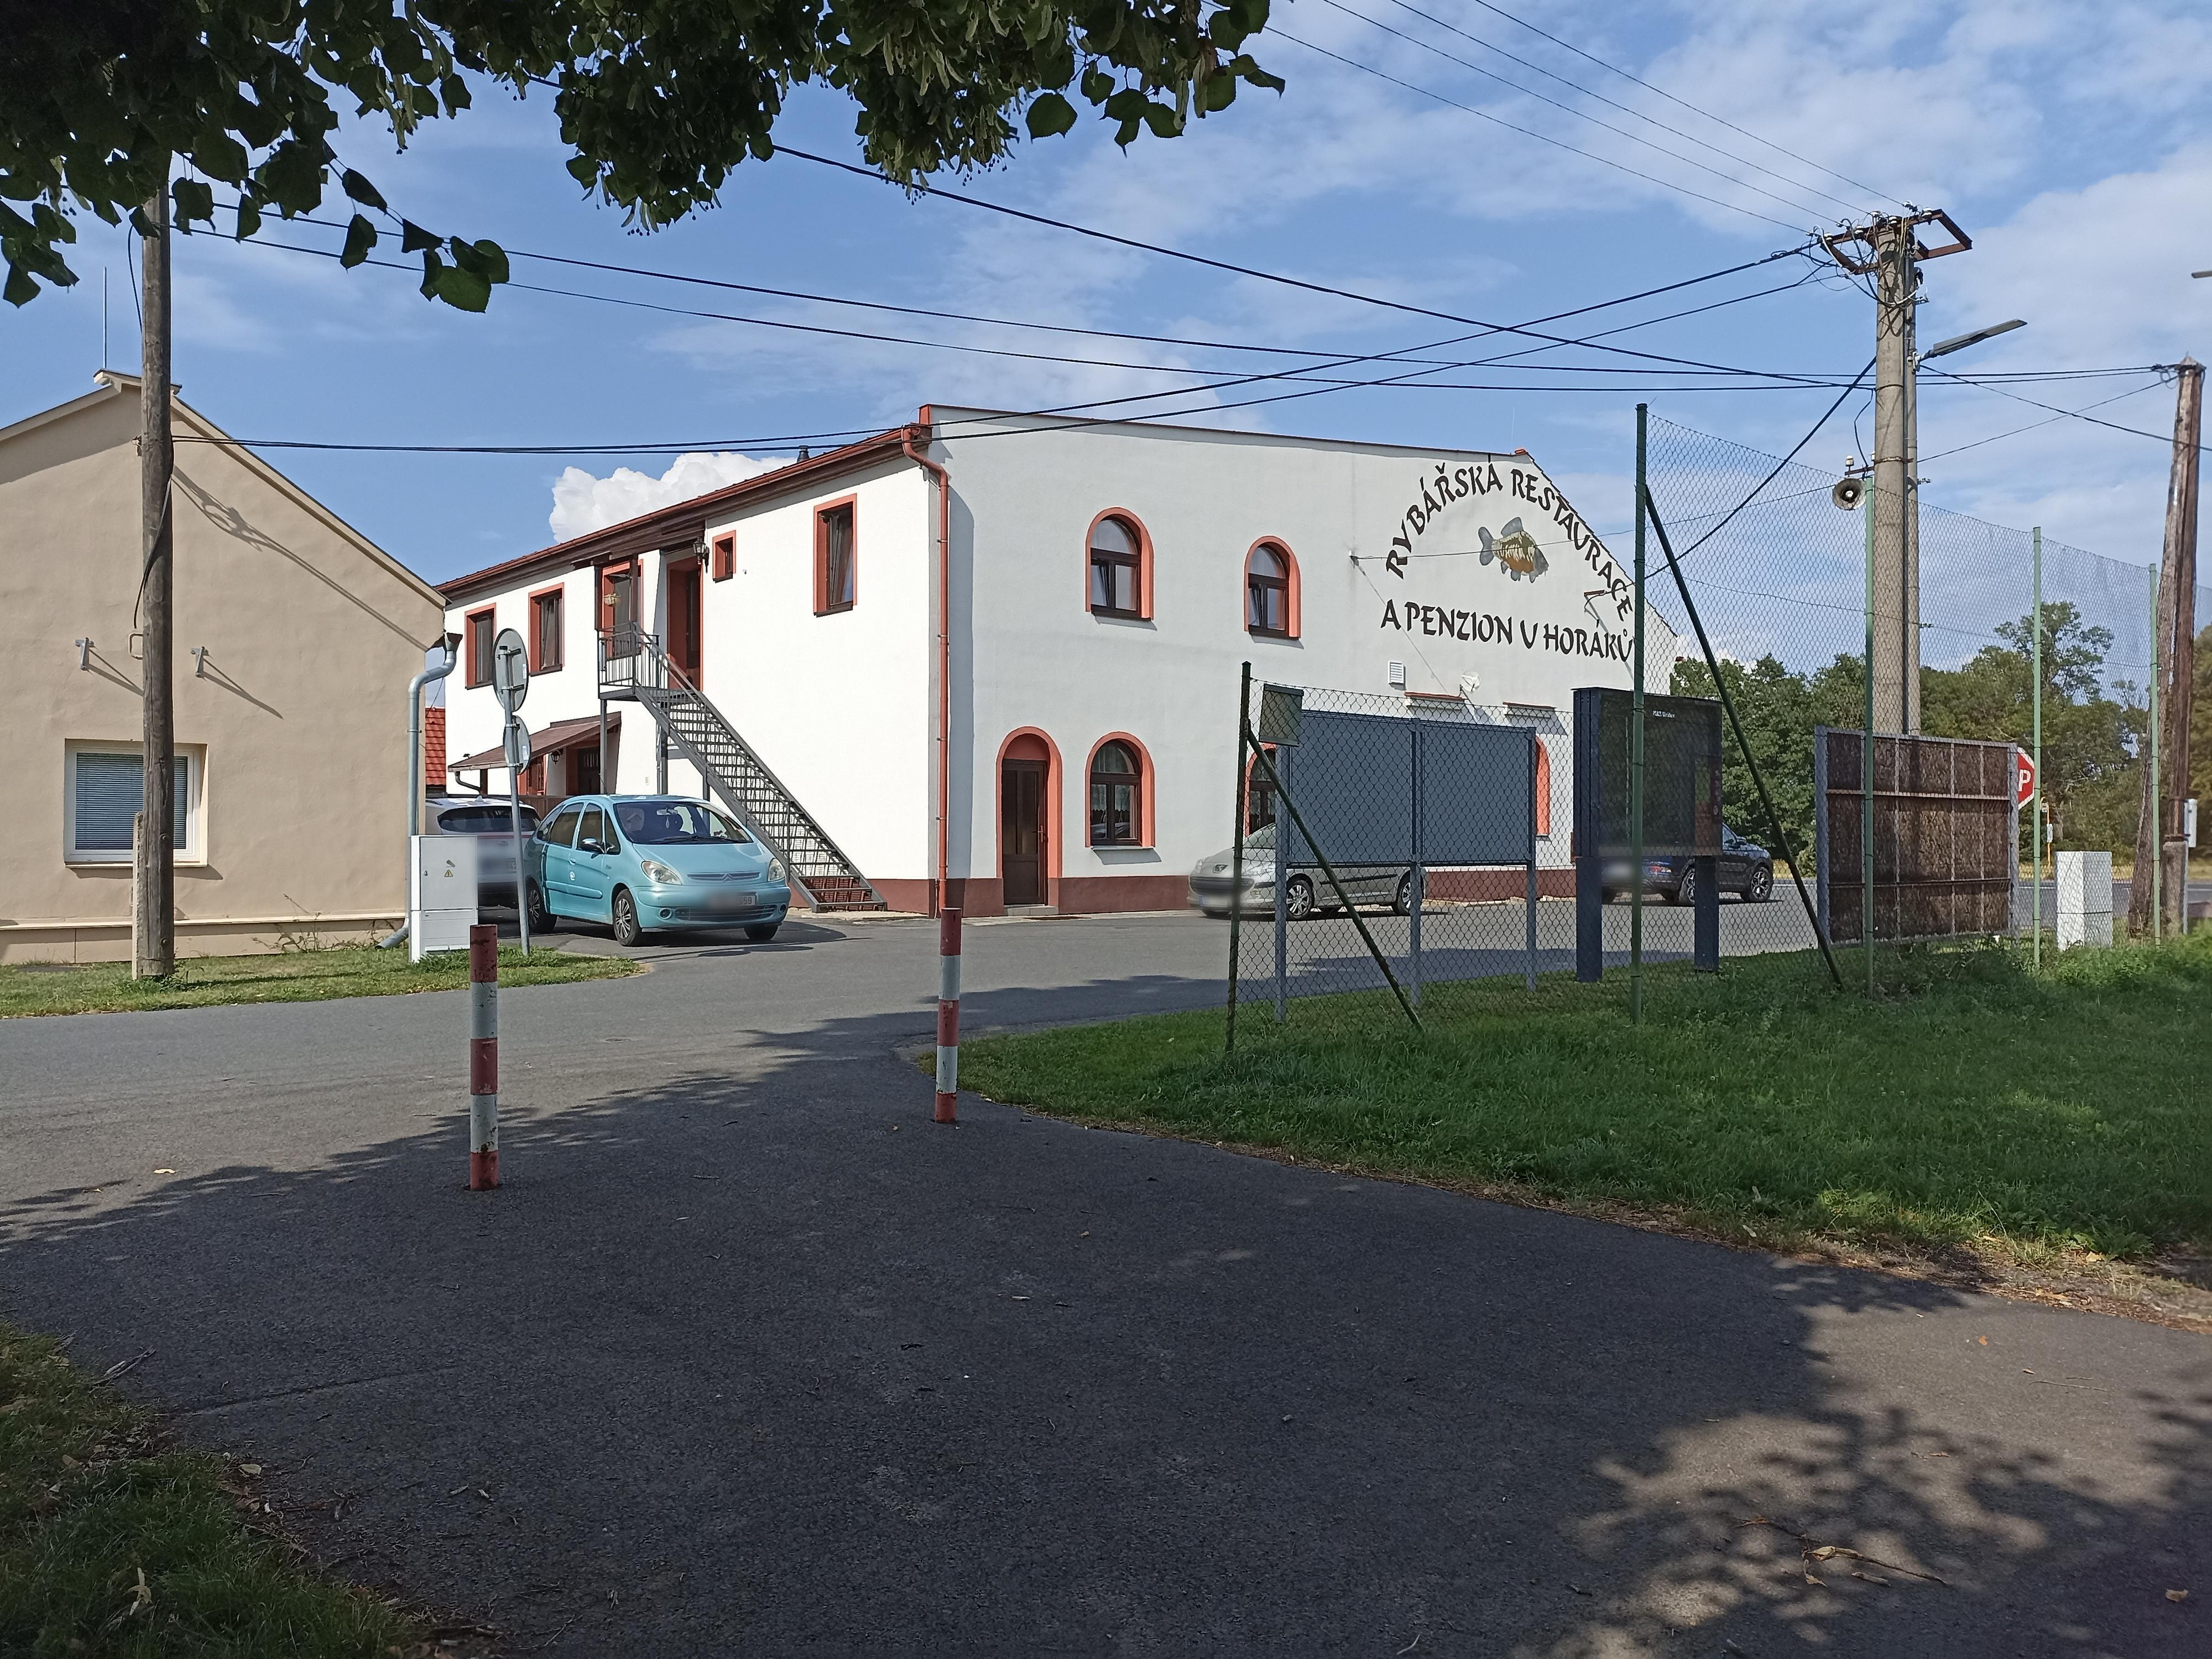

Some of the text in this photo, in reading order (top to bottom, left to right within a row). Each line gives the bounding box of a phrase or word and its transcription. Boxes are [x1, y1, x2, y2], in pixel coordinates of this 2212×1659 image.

[1386, 454, 1633, 622] RYBÁŘSKÁ RESTAURACE
[1381, 599, 1633, 662] A PENZION U HORÁKŮ
